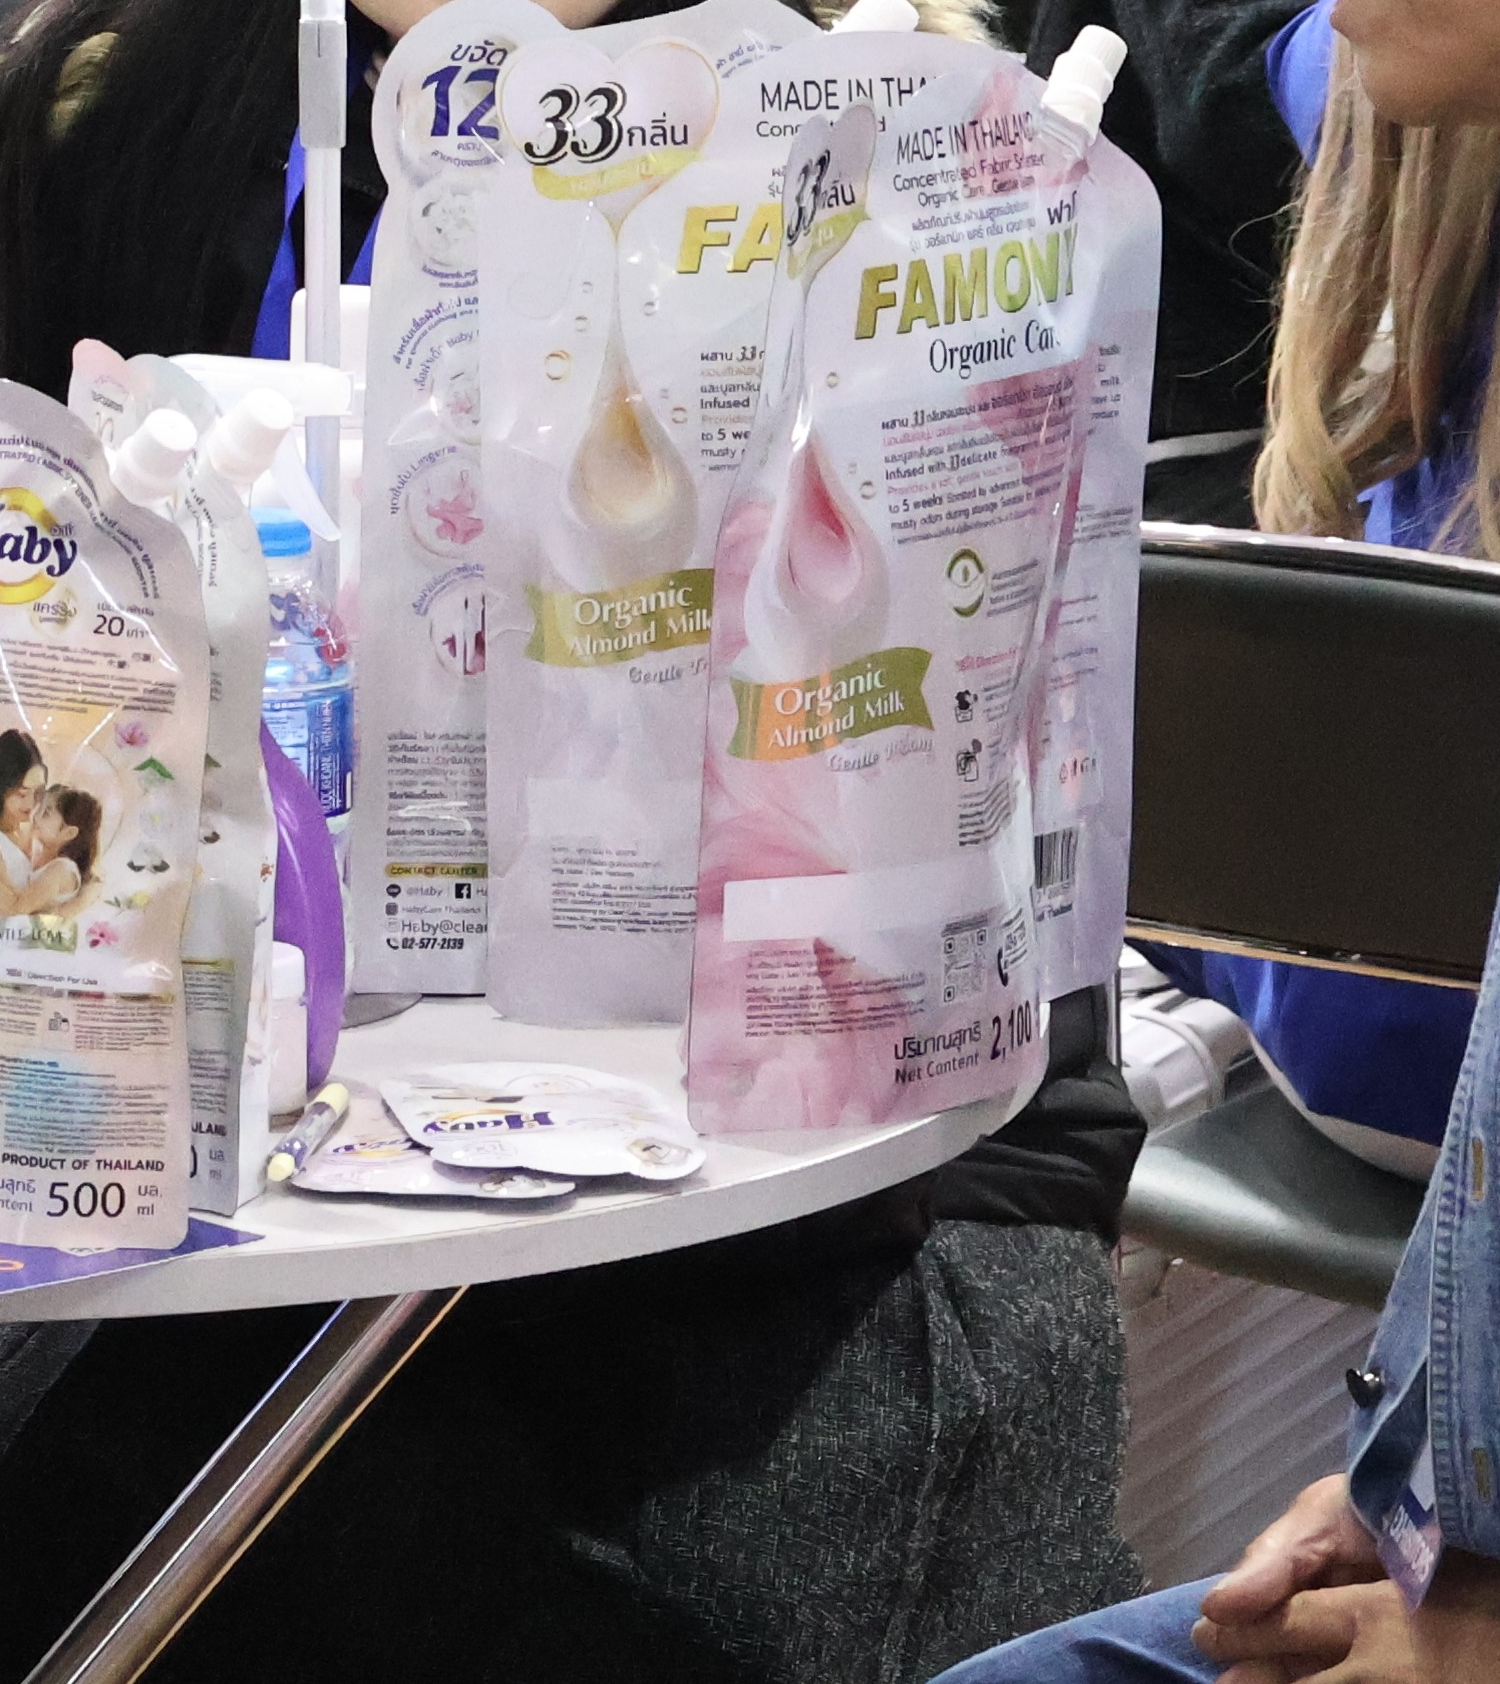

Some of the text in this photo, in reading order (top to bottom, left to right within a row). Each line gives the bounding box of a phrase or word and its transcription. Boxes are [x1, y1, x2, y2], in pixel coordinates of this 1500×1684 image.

[760, 79, 840, 113] MADE
[523, 81, 628, 167] 33
[896, 127, 947, 165] MADE
[949, 123, 968, 155] IN
[968, 111, 1034, 151] THAILAND
[929, 327, 1017, 380] Organic
[700, 396, 750, 409] Infused
[701, 428, 727, 442] to 5
[902, 498, 910, 512] 5
[573, 580, 693, 630] Organic
[93, 614, 125, 637] 20
[569, 622, 657, 657] Almond
[774, 662, 886, 716] Organic
[768, 690, 905, 749] Almond Milk
[989, 999, 1033, 1061] 2,100
[894, 1051, 980, 1084] Net Content
[1, 1152, 166, 1172] PRODUCT OF THAILAND
[47, 1182, 126, 1218] 500
[136, 1203, 155, 1216] ml
